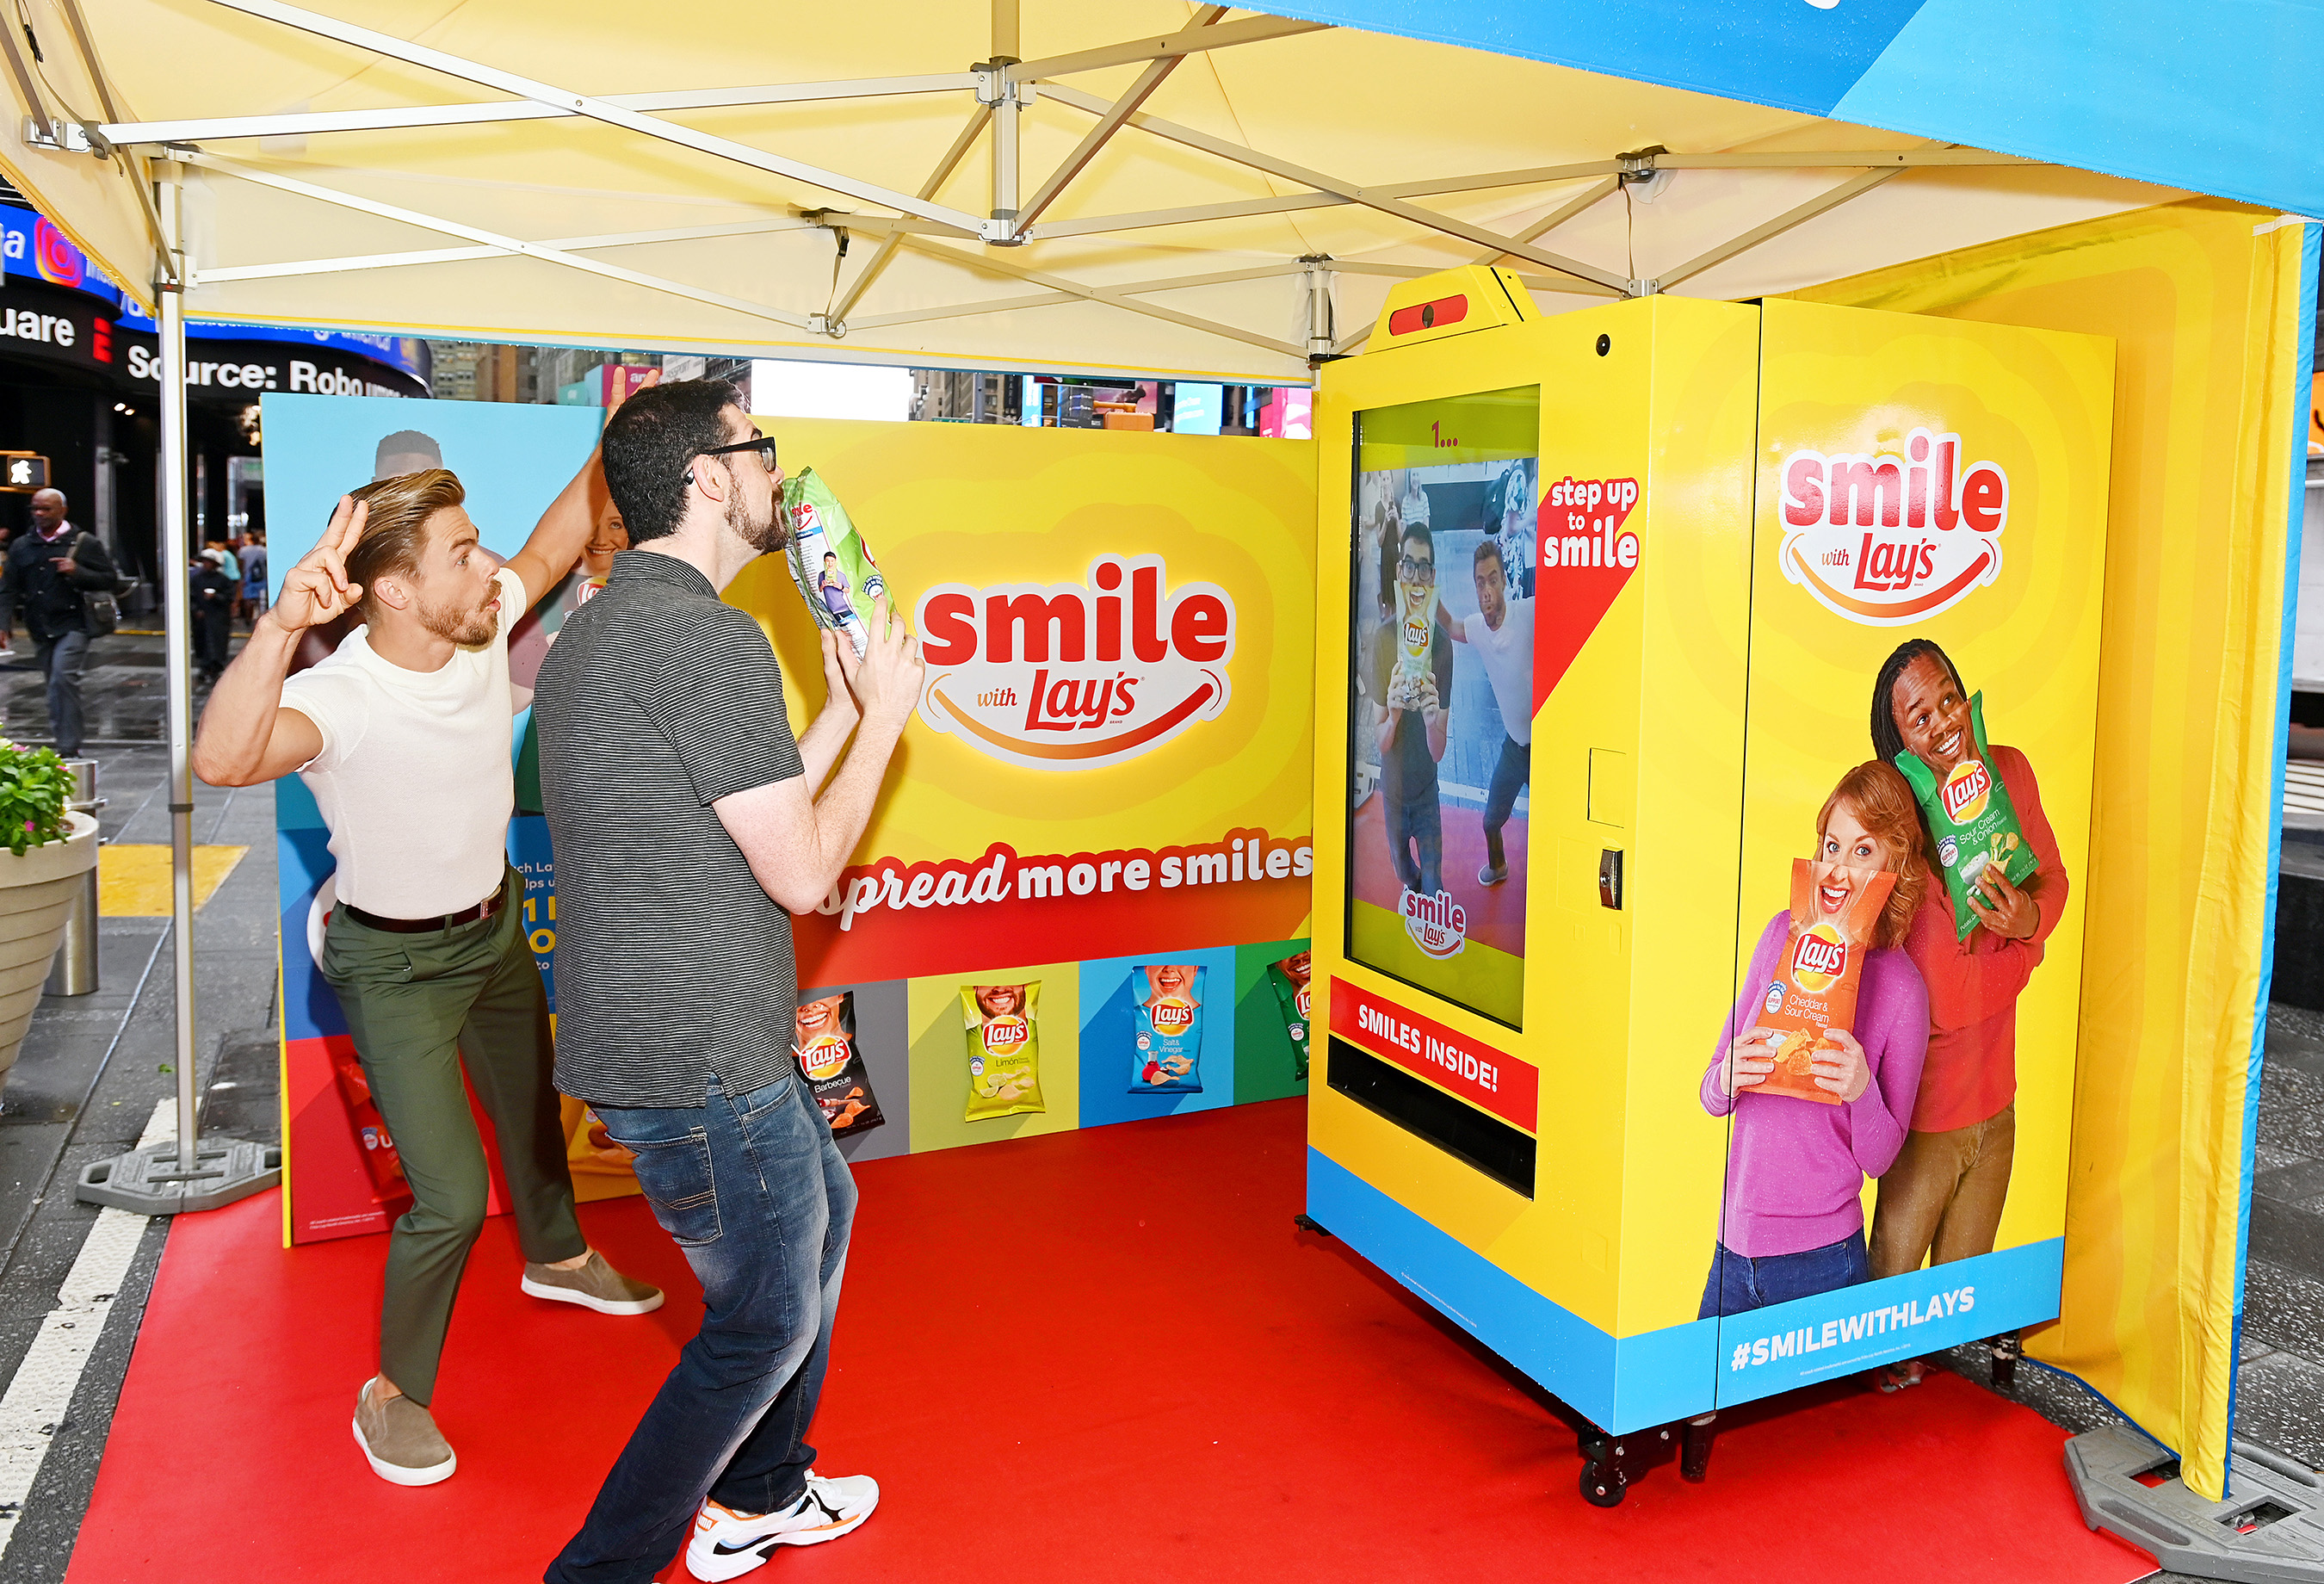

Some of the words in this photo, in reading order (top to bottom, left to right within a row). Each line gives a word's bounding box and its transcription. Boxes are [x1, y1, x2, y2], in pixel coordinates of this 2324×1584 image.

[1552, 478, 1602, 512] step
[1608, 482, 1637, 511] up
[1785, 436, 2003, 532] smile
[1567, 512, 1585, 530] to
[1543, 516, 1637, 568] smile
[1821, 548, 1850, 566] with
[1853, 532, 1937, 591] Lay's
[922, 561, 1229, 667] smile
[978, 688, 1017, 707] with
[1024, 669, 1139, 731] Lay's
[1947, 767, 1986, 816] Lay's
[1959, 826, 1977, 845] Sour
[1977, 808, 2000, 830] Cream
[1976, 821, 1998, 841] Onion
[524, 879, 545, 891] lps
[1017, 859, 1151, 899] more
[1159, 838, 1313, 888] smiles
[1406, 894, 1464, 933] smile
[1424, 923, 1445, 946] Lay's
[1795, 935, 1845, 973] Lay's
[1154, 1005, 1190, 1025] Lay's
[1784, 1005, 1803, 1017] Sour
[1803, 1009, 1829, 1023] Cream
[1789, 994, 1822, 1010] Cheddar
[1822, 1002, 1828, 1012] &
[986, 1024, 1024, 1046] Lay's
[1159, 1046, 1184, 1055] Vinegar
[1358, 1005, 1421, 1055] SMILES
[1425, 1035, 1499, 1093] INSIDE!
[806, 1042, 844, 1073] Lay's
[995, 1058, 1019, 1067] Limón
[813, 1076, 851, 1094] Barbecue
[1731, 1286, 1975, 1371] #SMILEWITHLAYS
